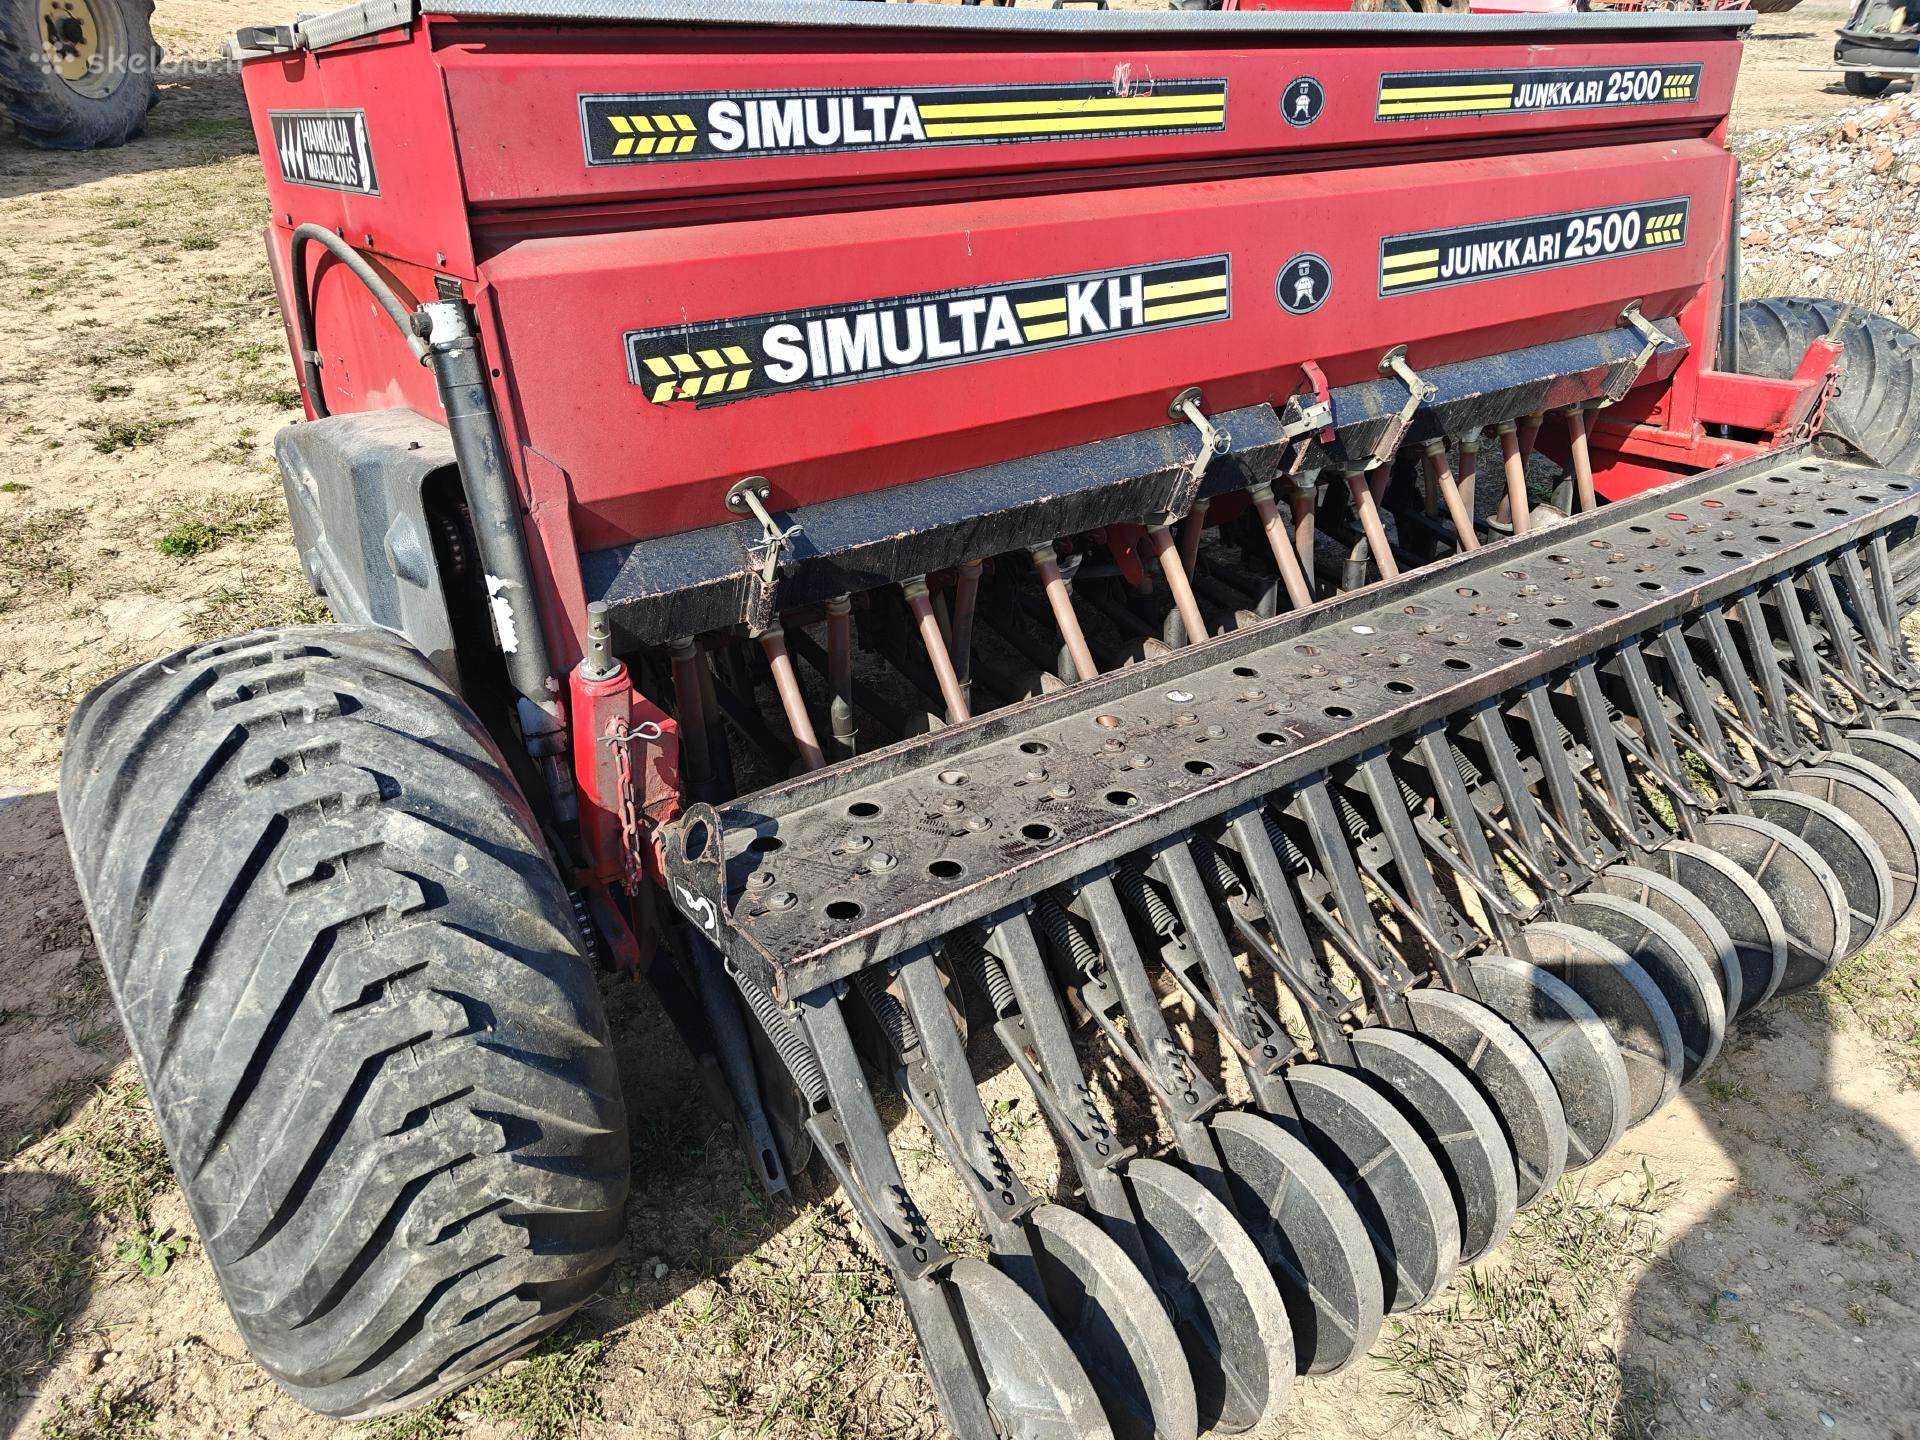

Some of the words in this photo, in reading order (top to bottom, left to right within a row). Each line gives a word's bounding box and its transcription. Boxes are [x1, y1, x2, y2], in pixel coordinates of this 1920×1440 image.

[1514, 80, 1603, 108] JUNKKARI
[1605, 70, 1662, 102] 2500
[300, 118, 353, 155] HANKKIJA
[707, 95, 926, 151] SIMULTA
[306, 152, 358, 185] MAATALOUS
[1440, 232, 1561, 278] JUNKKARI
[1565, 210, 1641, 258] 2500
[762, 294, 1025, 384] SIMULTA
[1066, 273, 1144, 337] KH
